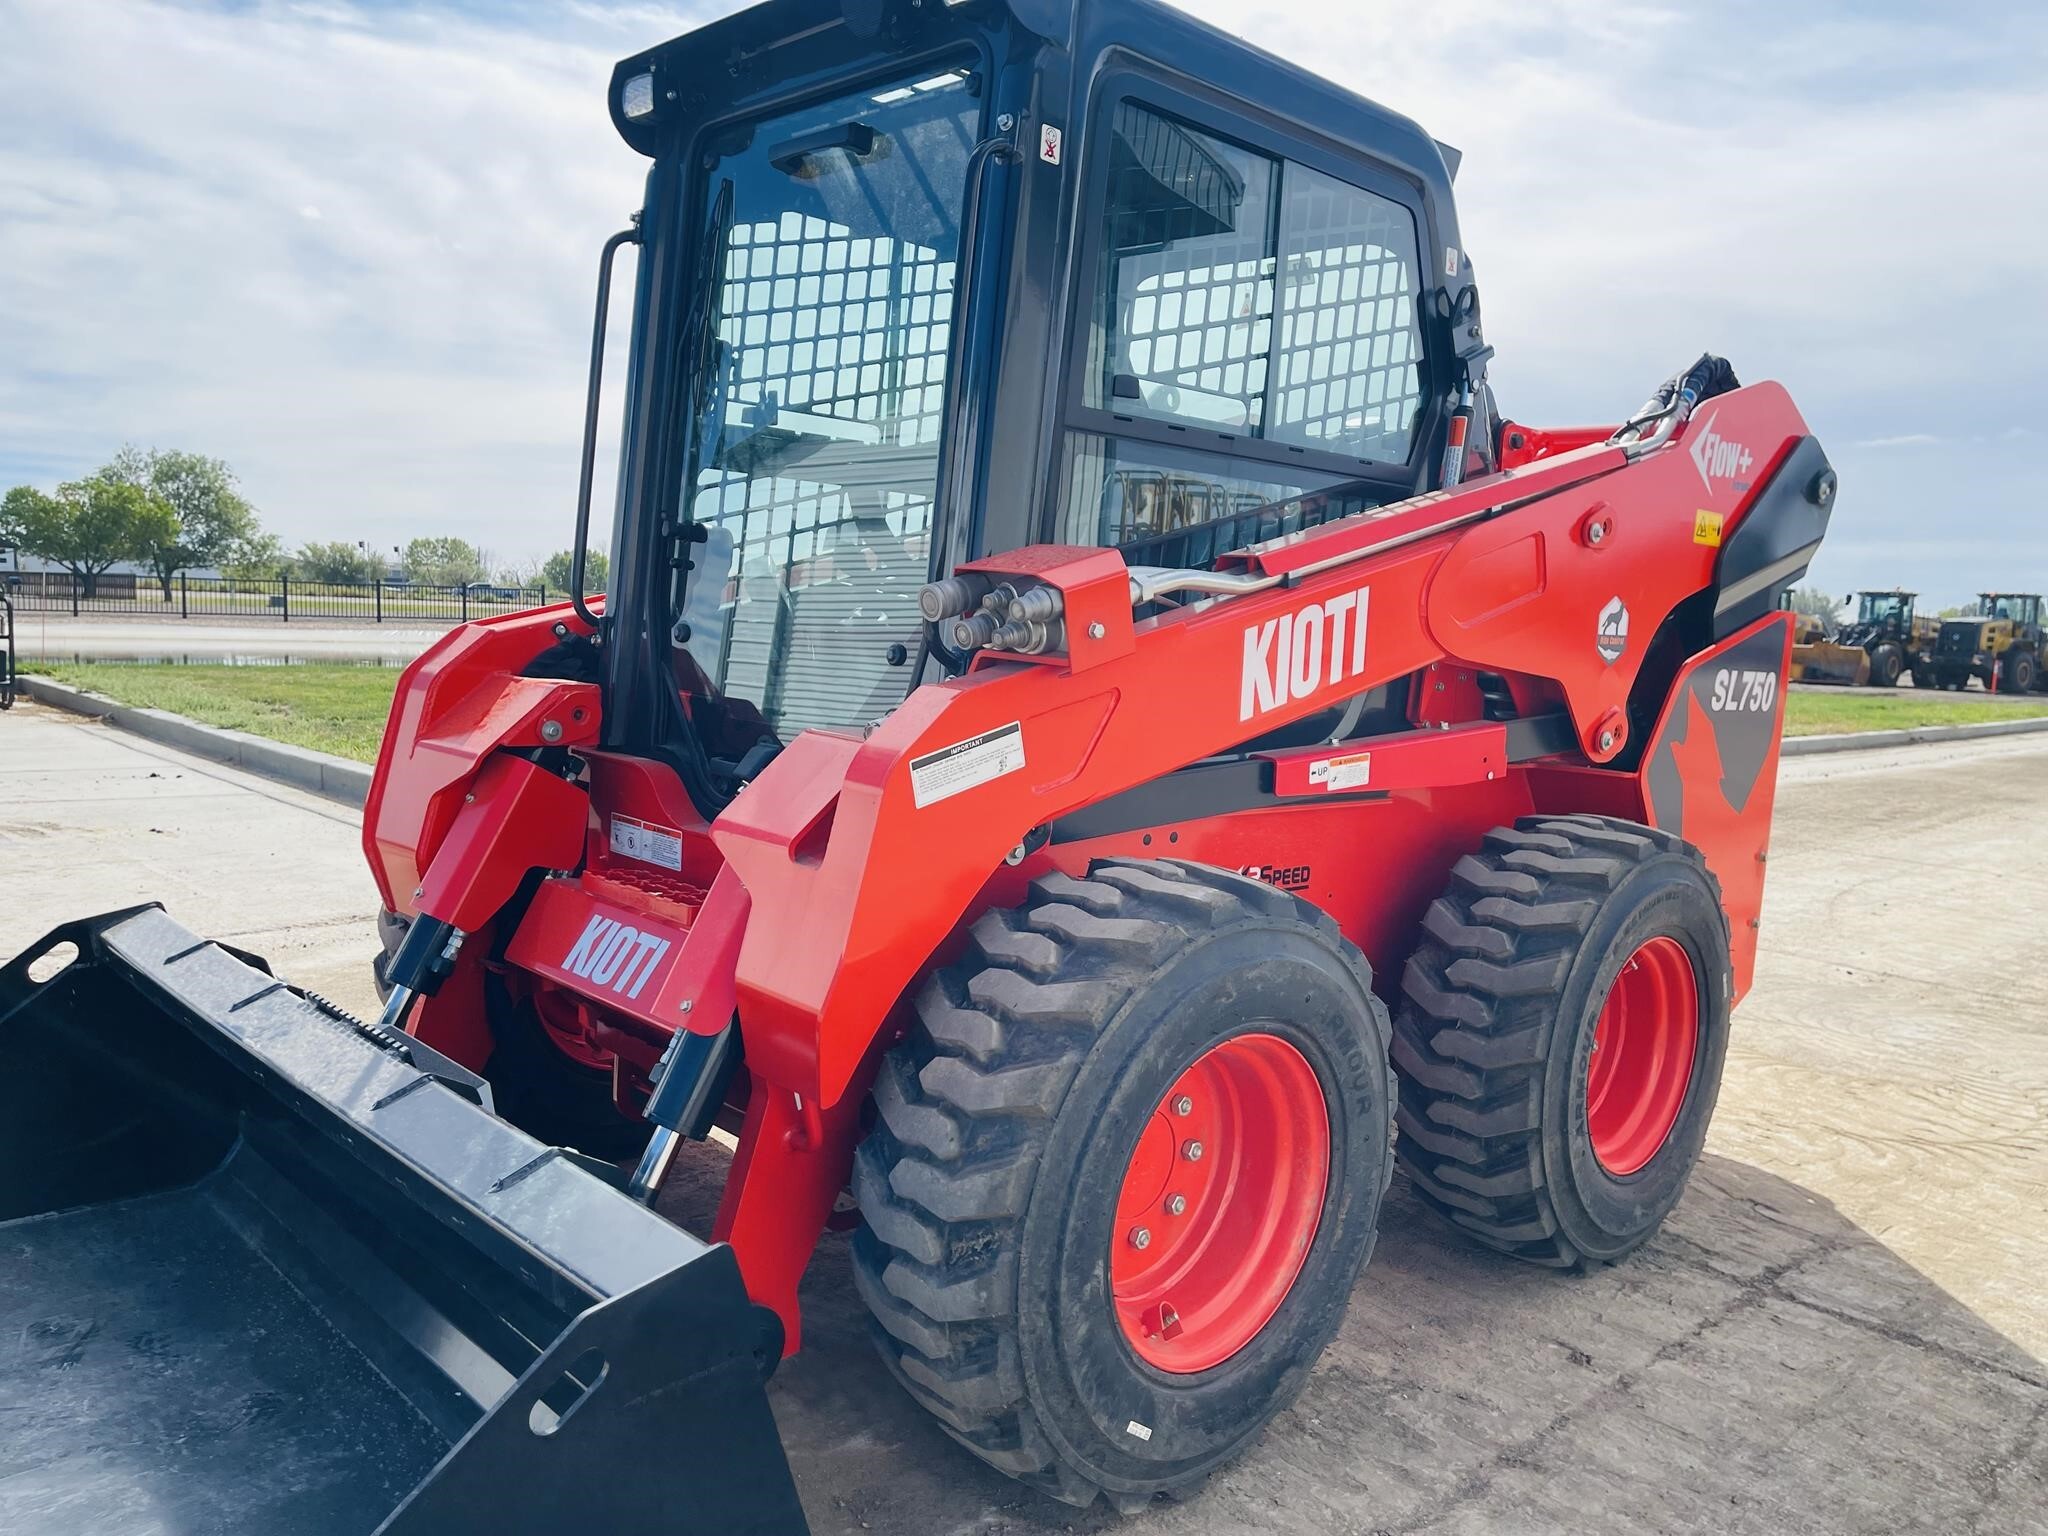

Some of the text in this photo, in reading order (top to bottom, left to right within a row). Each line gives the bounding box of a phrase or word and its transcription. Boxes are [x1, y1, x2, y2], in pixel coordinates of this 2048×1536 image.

[1240, 585, 1370, 722] KIOTI
[1711, 668, 1777, 712] SL750
[950, 738, 984, 756] IMPORTANT
[1317, 766, 1328, 777] UP
[560, 914, 671, 1000] KIOTI
